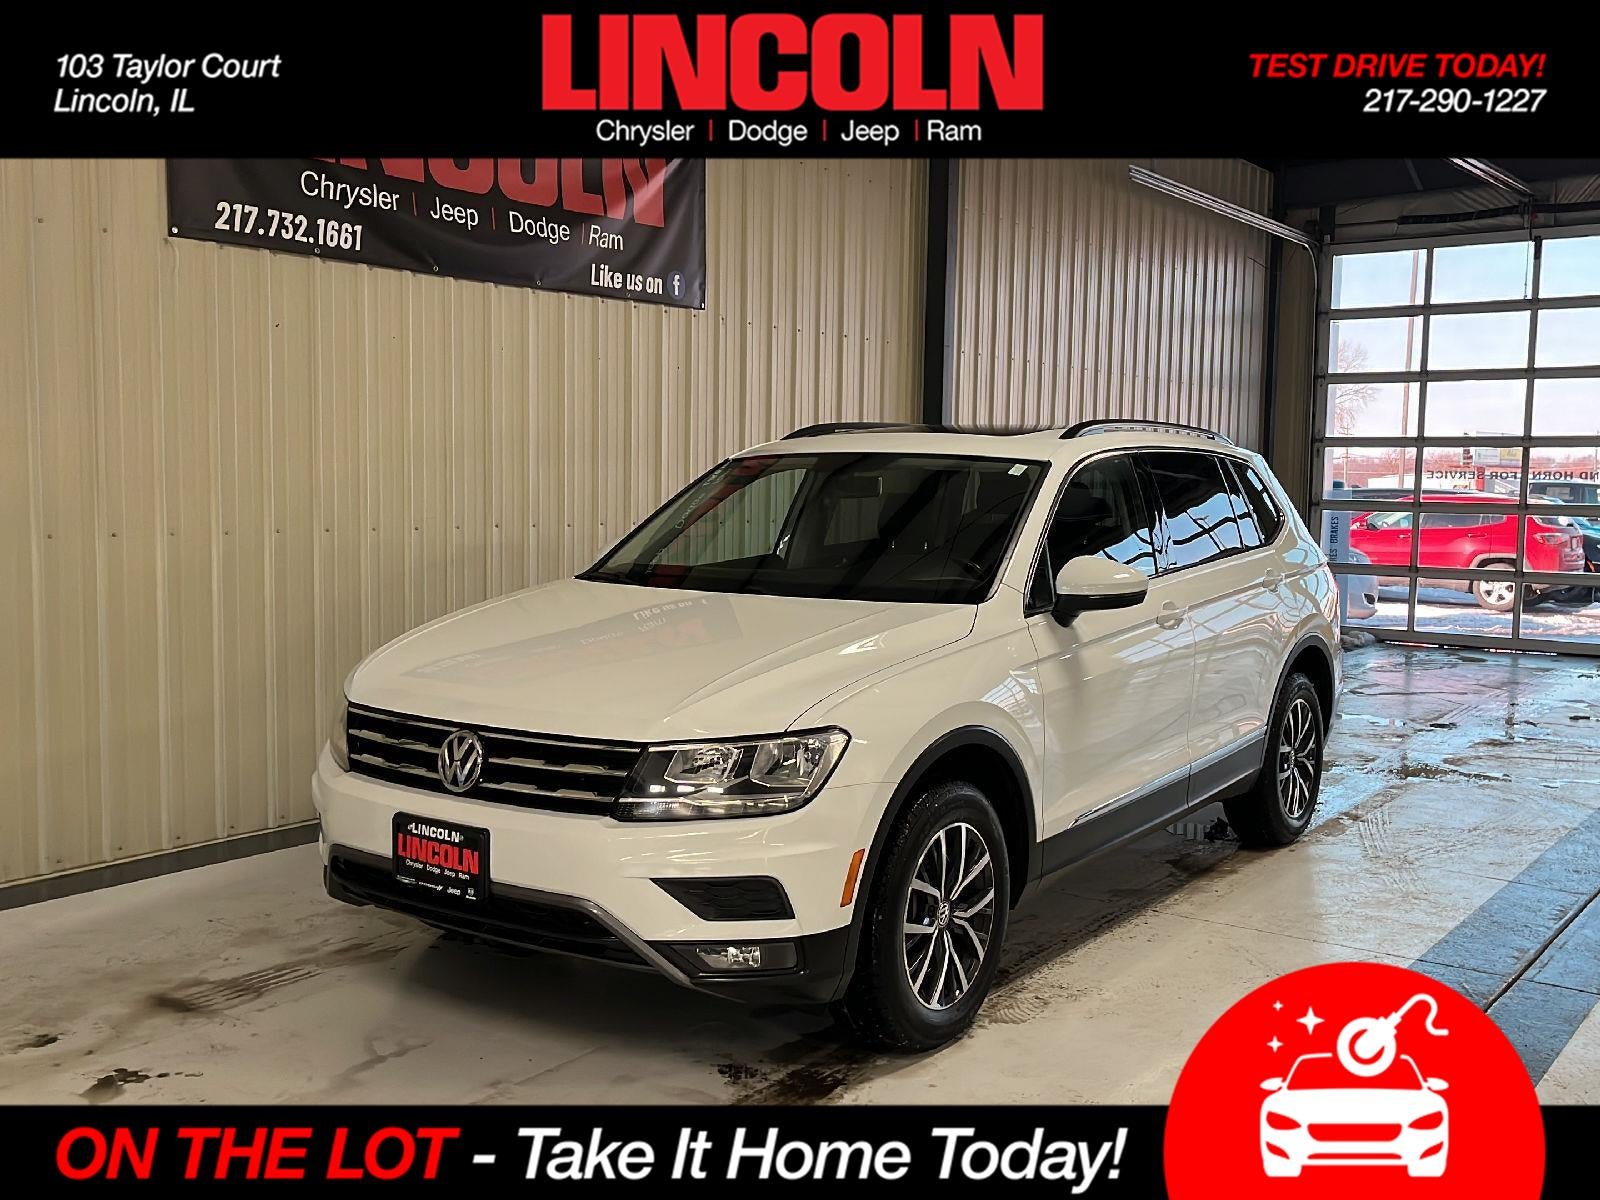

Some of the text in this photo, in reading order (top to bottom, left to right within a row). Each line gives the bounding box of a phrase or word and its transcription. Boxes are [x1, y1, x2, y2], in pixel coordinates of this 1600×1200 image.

[300, 170, 400, 211] Chrysler
[429, 196, 479, 230] Jeep
[508, 210, 571, 244] Dodge
[588, 224, 624, 251] Ram
[214, 201, 363, 251] 217.732.1661
[590, 263, 623, 290] Like
[626, 274, 643, 292] us
[646, 276, 663, 295] on
[1330, 516, 1339, 544] BRAKES
[411, 822, 461, 843] LINCOLN
[397, 832, 480, 876] LINCOLN
[426, 864, 441, 875] Dodge
[458, 872, 470, 881] Ram
[446, 886, 461, 896] Jeep
